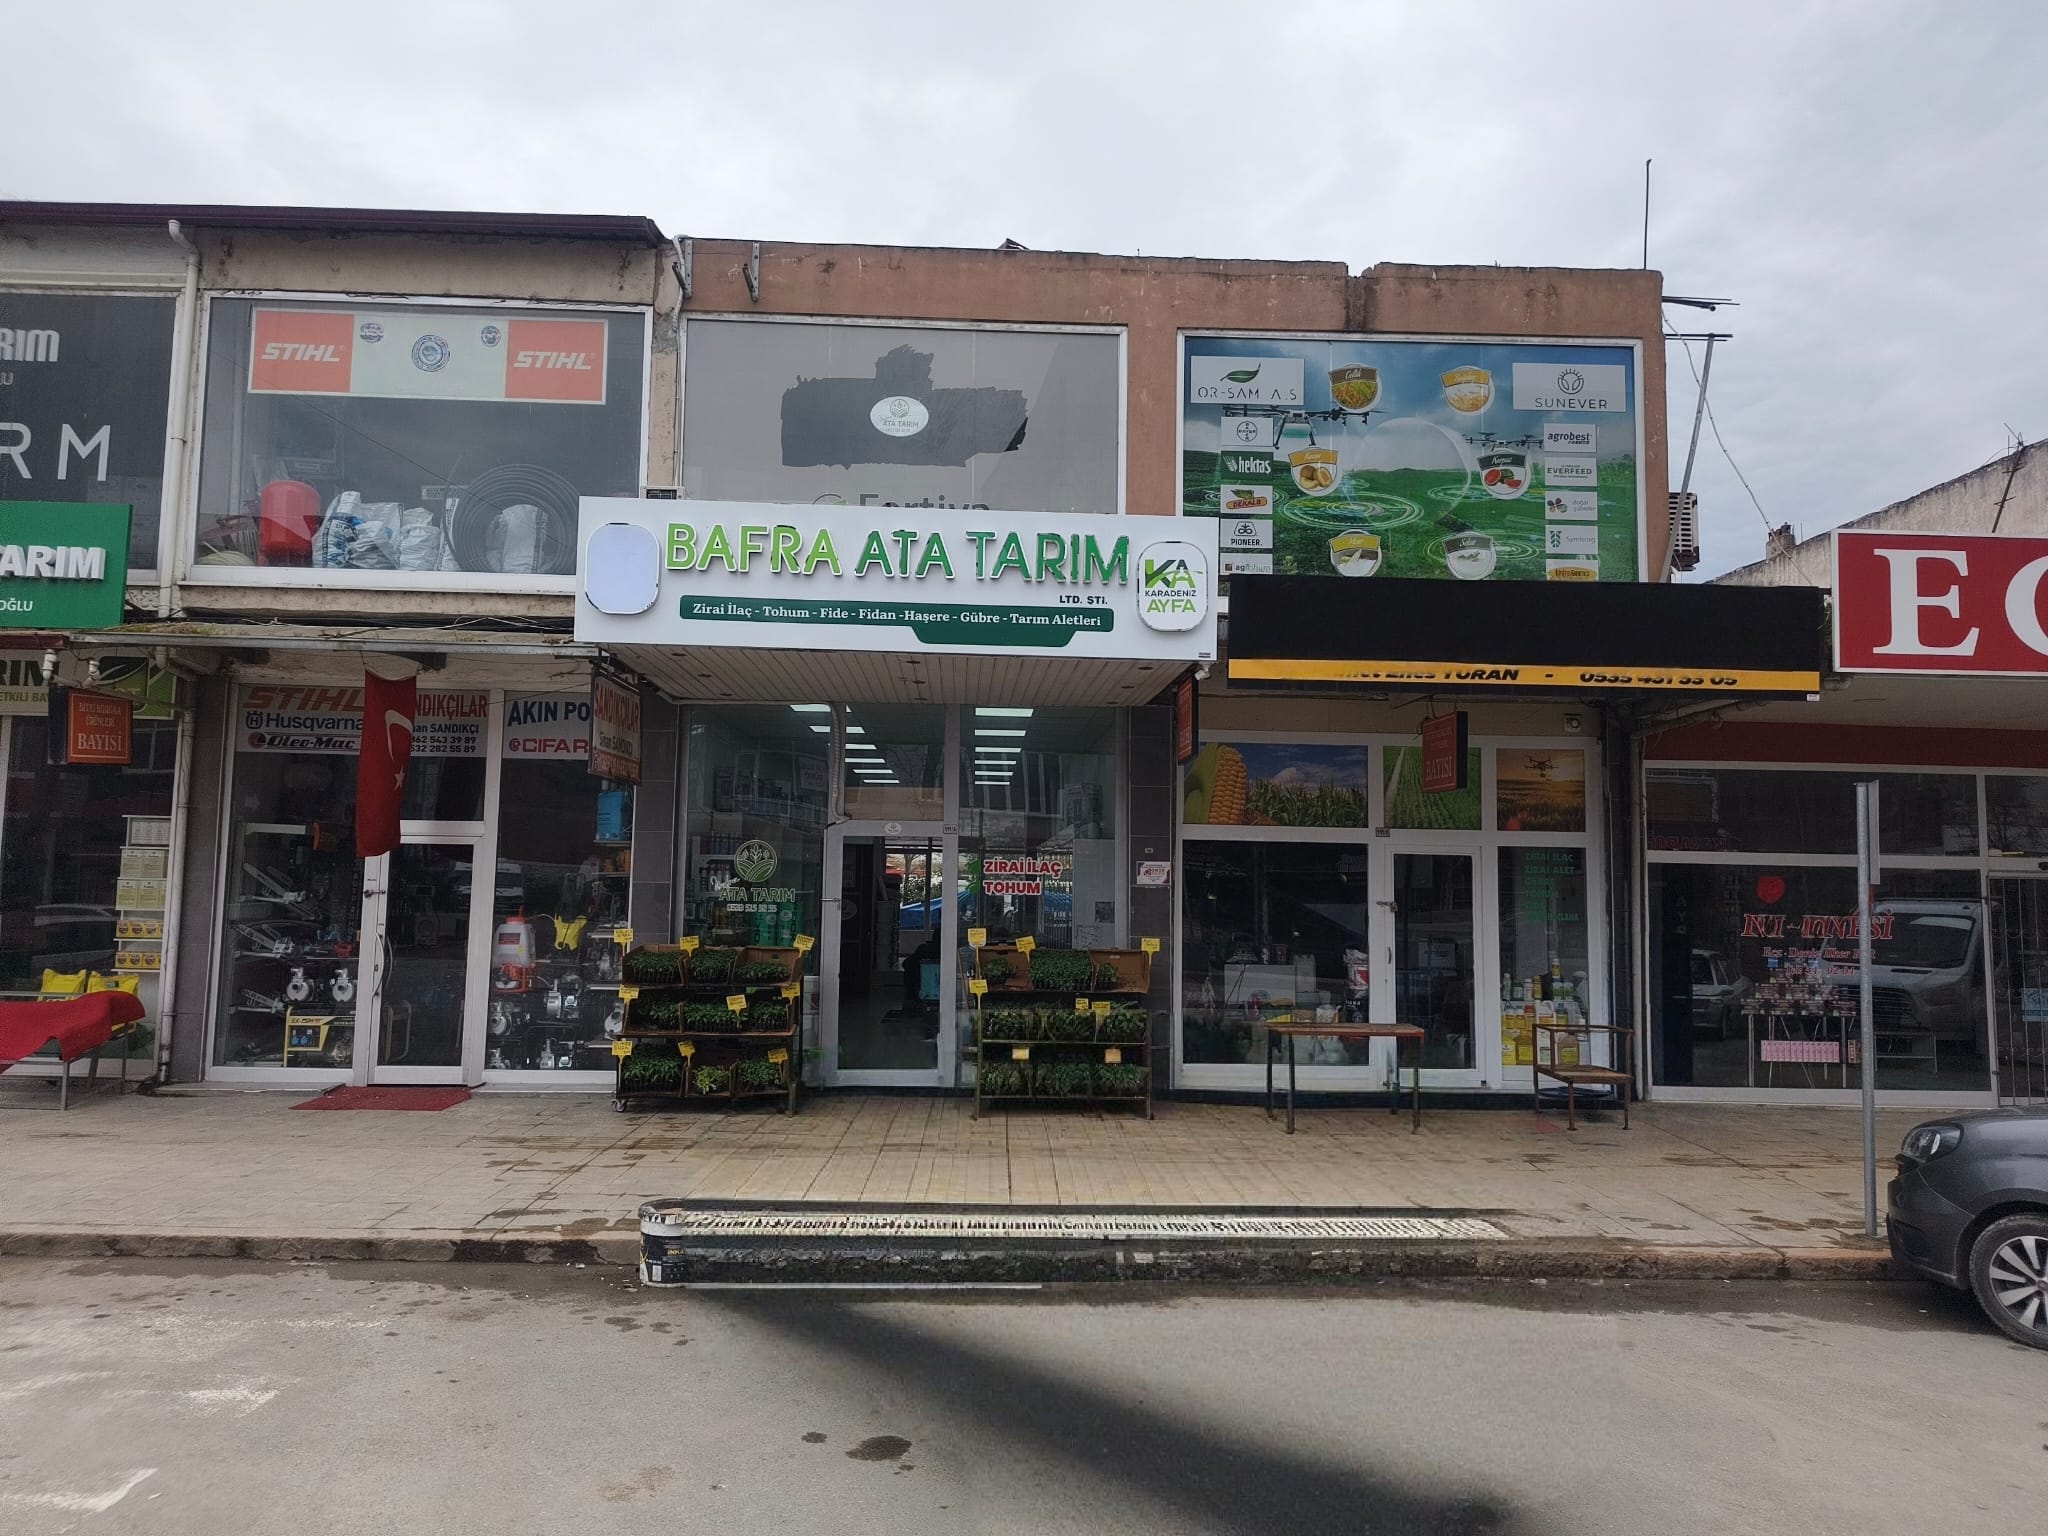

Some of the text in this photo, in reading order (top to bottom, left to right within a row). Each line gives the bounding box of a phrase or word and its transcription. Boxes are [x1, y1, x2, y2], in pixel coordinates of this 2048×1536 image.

[261, 342, 342, 363] STIHL
[513, 350, 593, 371] STIHL
[1197, 387, 1260, 400] OR-SAM
[1534, 397, 1608, 409] SUNEVER
[1547, 431, 1591, 442] agrobest
[1547, 467, 1592, 475] EVERFEED
[665, 522, 1130, 585] BAFRA ATA TARIM
[0, 545, 106, 581] ARIM
[1059, 595, 1083, 604] LTD.
[1146, 599, 1197, 613] AYFA
[693, 603, 725, 614] Zirai
[727, 602, 752, 618] İlaç
[763, 606, 810, 618] Tohum
[819, 607, 849, 618] Fide
[858, 608, 896, 619] Fidan
[960, 611, 1001, 623] Gübre
[1010, 613, 1050, 625] Tarım
[1052, 614, 1101, 626] Aletleri
[32, 692, 49, 703] BA
[242, 686, 366, 712] STIHL
[507, 700, 591, 727] AKIN PO
[265, 712, 365, 732] Husqvarna
[430, 723, 479, 735] SANDIKÇI
[77, 731, 123, 751] BAYİSİ
[266, 735, 357, 749] Oleo-Mac
[430, 736, 448, 744] 543
[449, 736, 462, 744] 39
[464, 736, 477, 745] 89
[522, 738, 589, 754] CIFAR
[429, 745, 448, 753] 282
[450, 745, 462, 753] 55
[464, 745, 476, 753] 89
[984, 857, 1062, 878] ZİRAİ İLAÇ
[718, 887, 796, 902] ATA TARIM
[984, 881, 1041, 894] TOHUM
